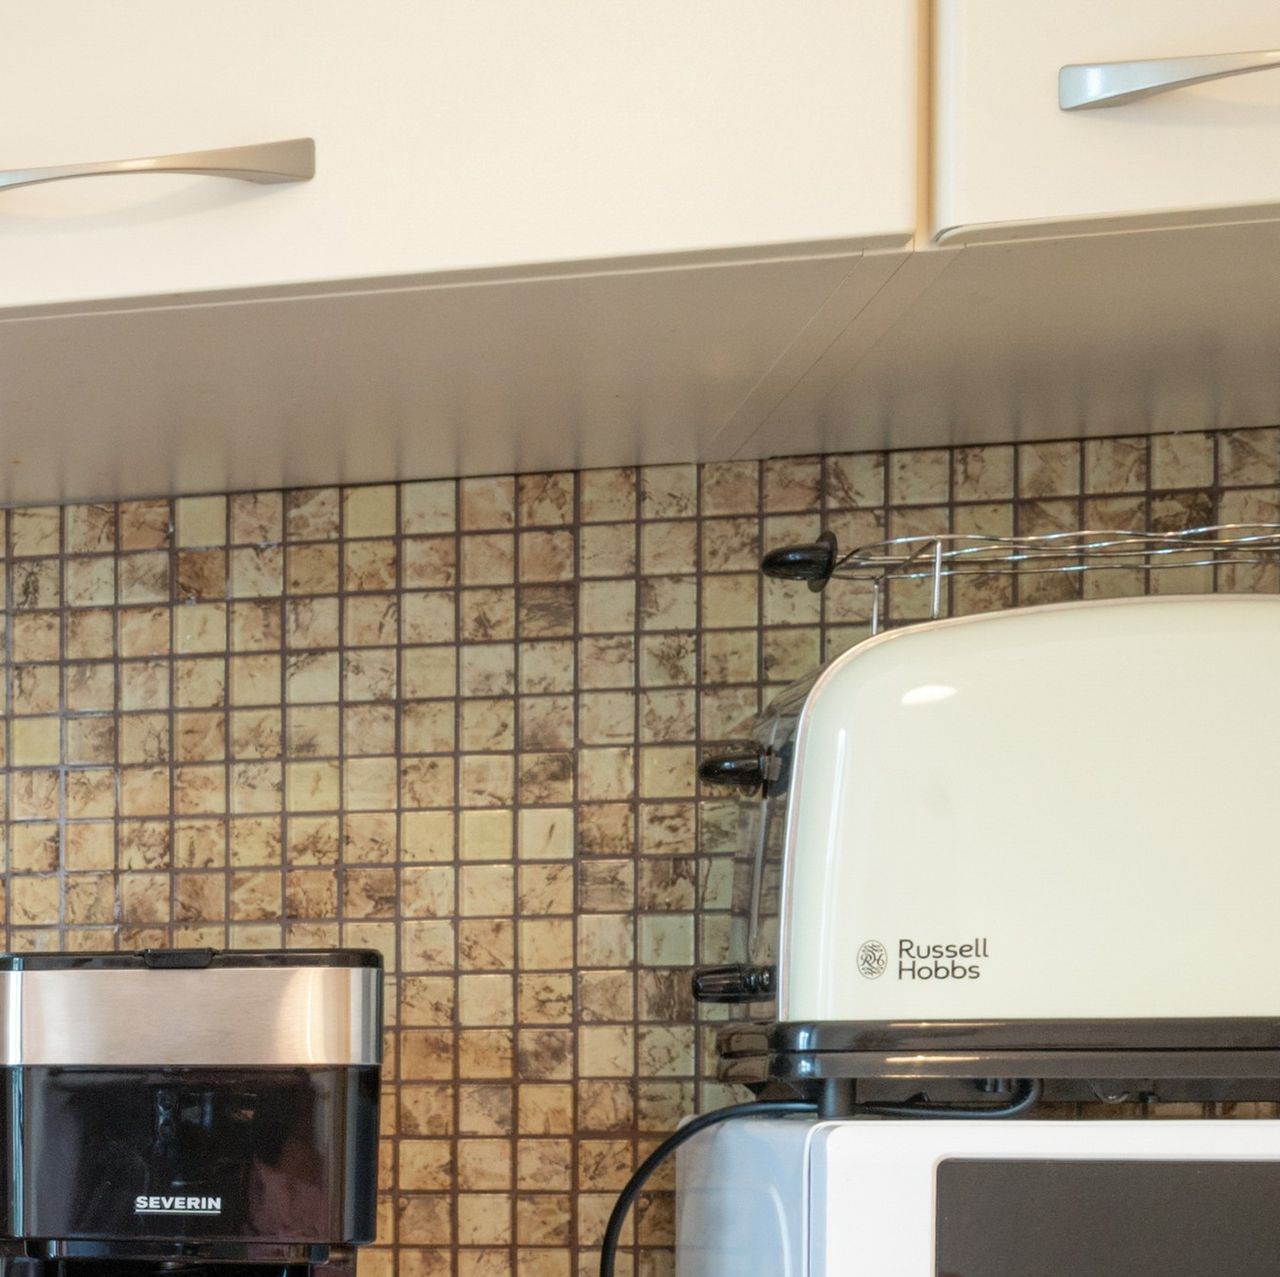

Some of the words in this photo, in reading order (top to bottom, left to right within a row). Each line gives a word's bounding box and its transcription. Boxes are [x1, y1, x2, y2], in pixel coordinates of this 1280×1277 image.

[898, 937, 989, 960] Russell
[898, 959, 981, 980] Hobbs
[135, 1195, 222, 1210] SEVERIN
